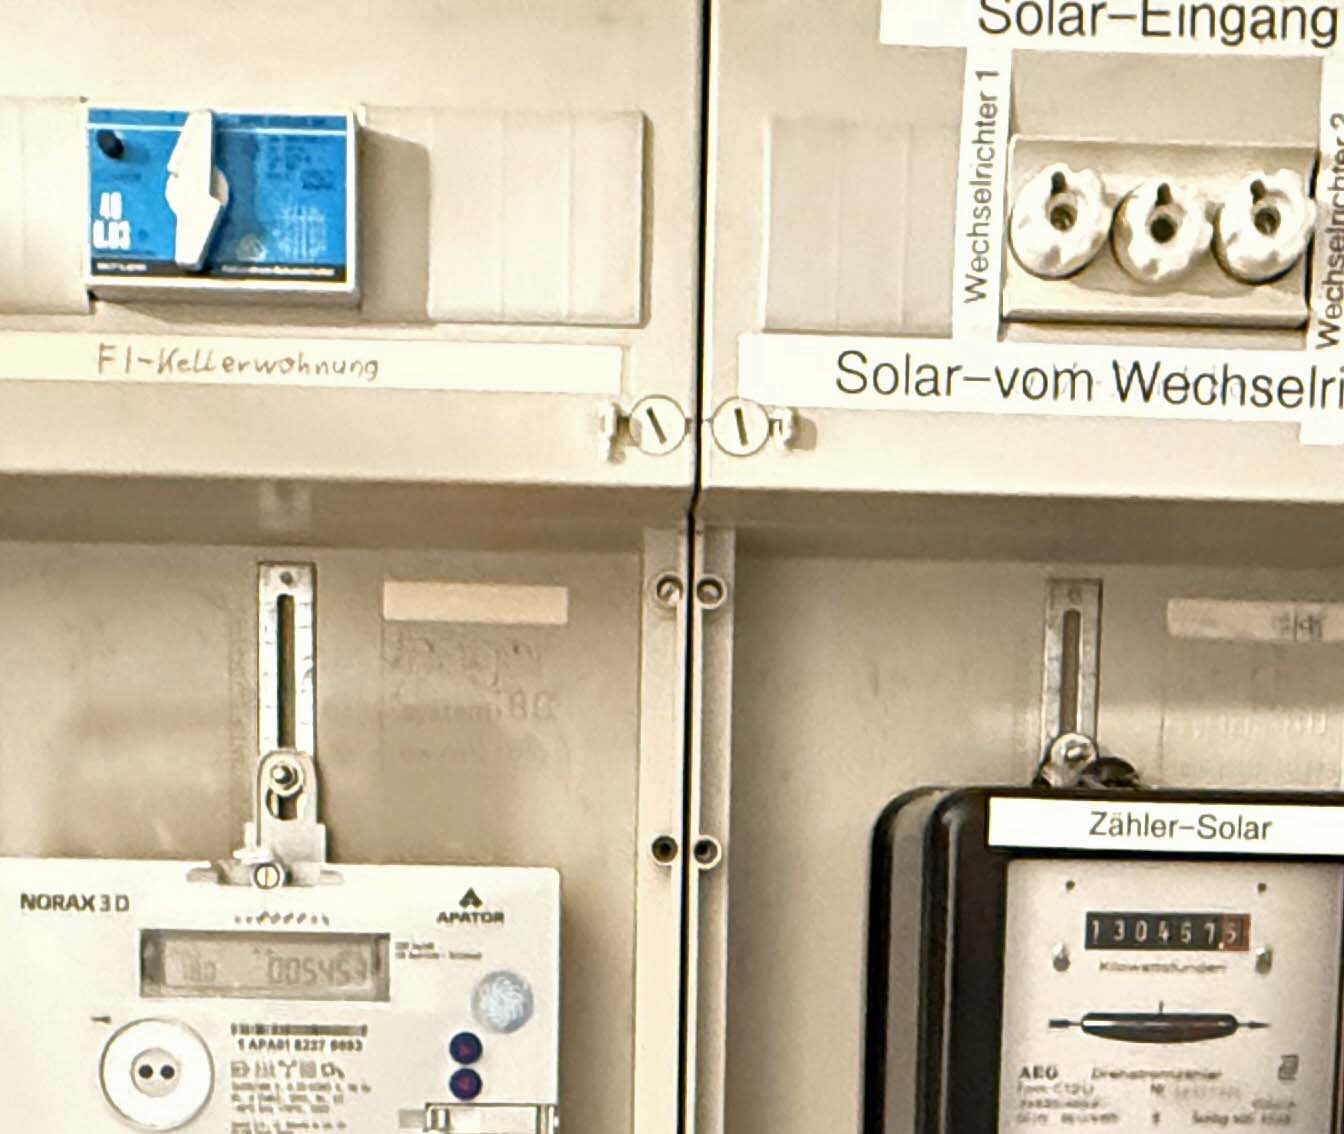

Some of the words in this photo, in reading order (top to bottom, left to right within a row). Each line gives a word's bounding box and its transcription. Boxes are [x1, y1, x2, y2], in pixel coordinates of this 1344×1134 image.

[974, 69, 1000, 81] 1
[963, 90, 999, 303] Wechselrichter
[835, 349, 1094, 401] Solar-vom
[1087, 809, 1274, 842] Zähler-Solar
[20, 893, 96, 912] NORAX
[436, 911, 505, 924] APATOR
